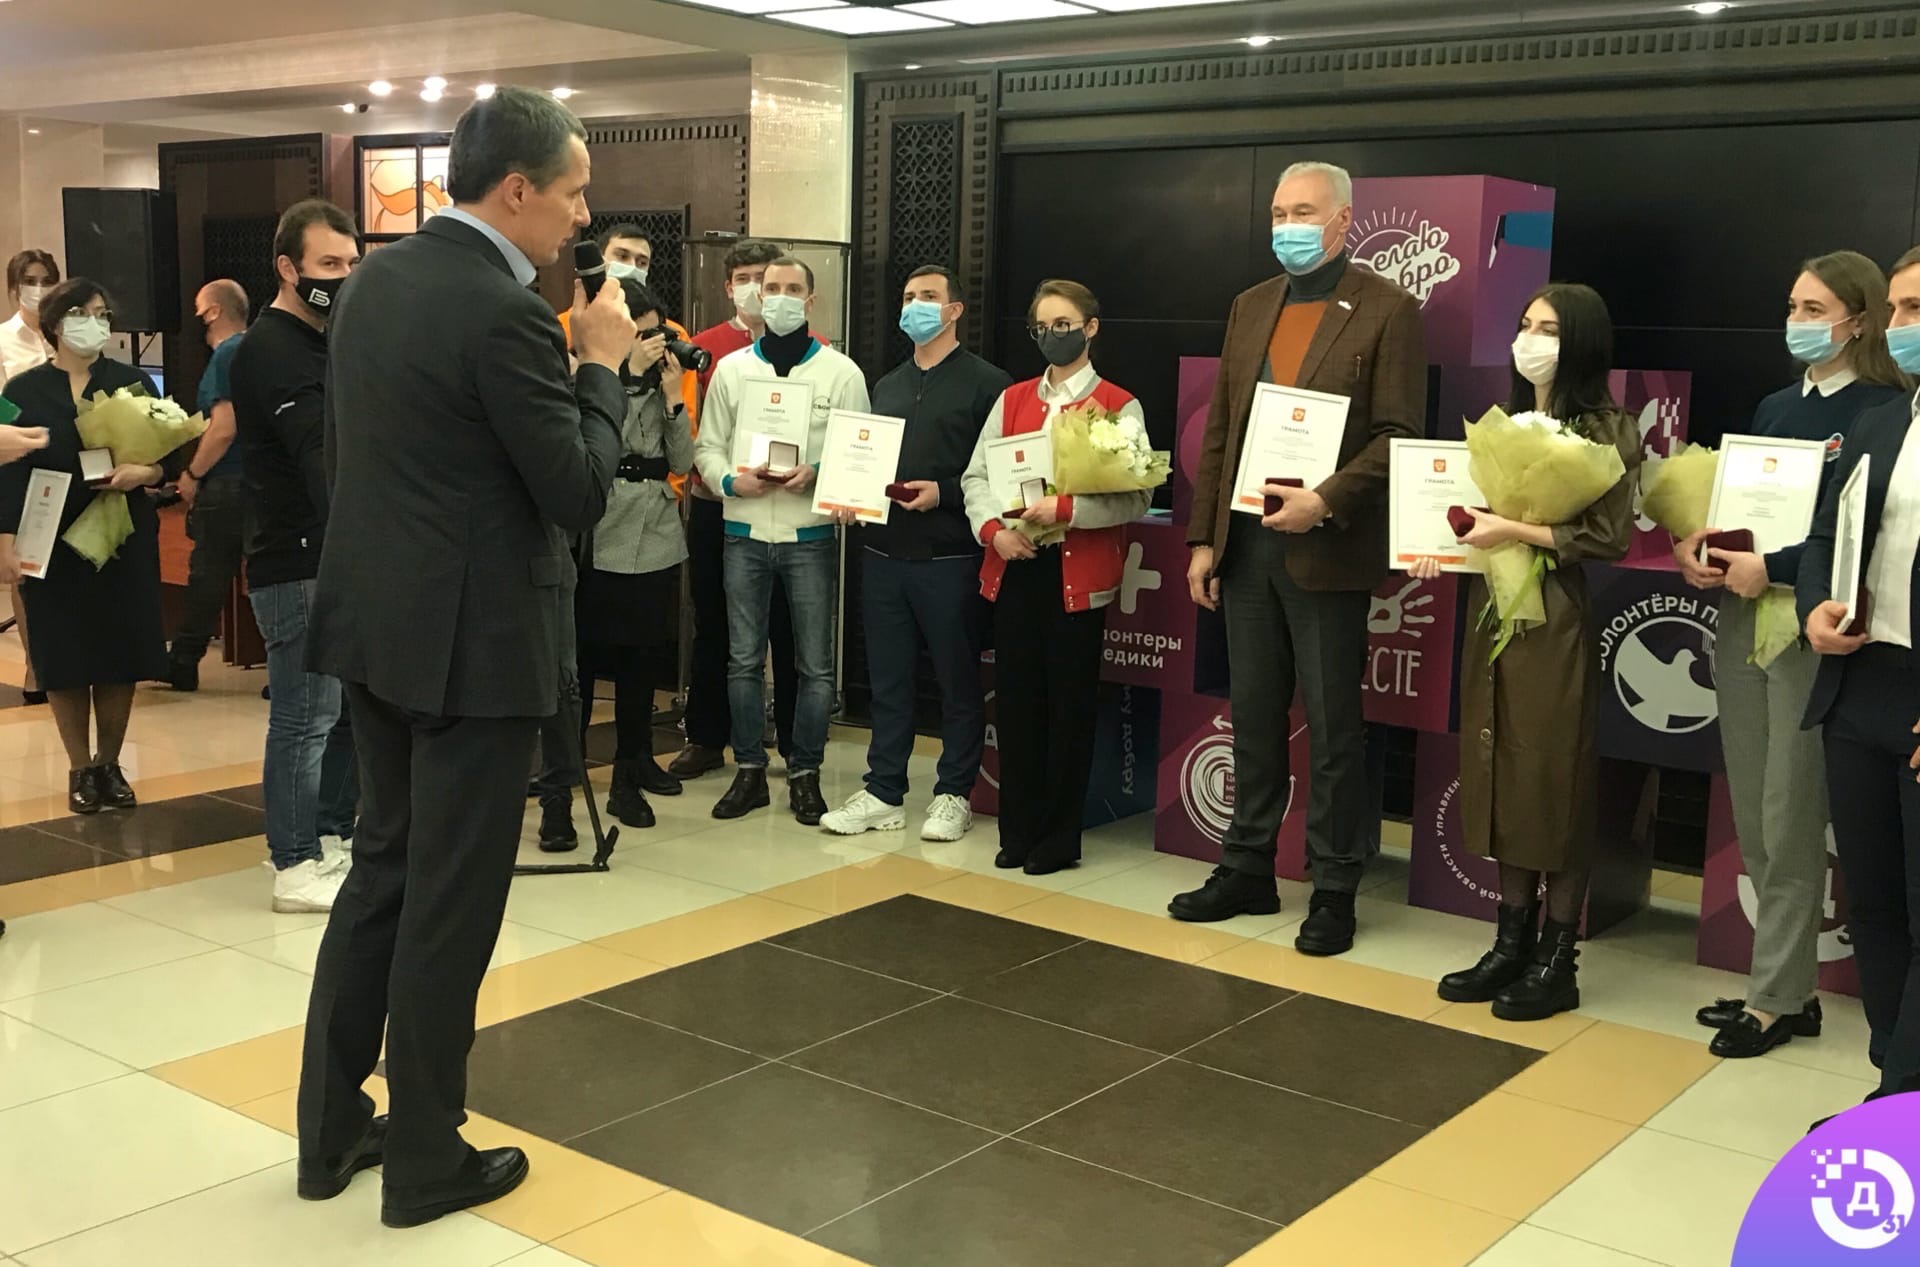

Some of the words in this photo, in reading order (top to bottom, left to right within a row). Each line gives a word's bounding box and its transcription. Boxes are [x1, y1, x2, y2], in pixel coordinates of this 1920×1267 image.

[1373, 221, 1448, 272] елаю
[1399, 255, 1455, 295] бро
[1600, 593, 1698, 672] ОЛОНТЁРЫ
[1103, 648, 1164, 669] едики
[1436, 776, 1461, 837] УПРАВЛЕН
[1440, 843, 1477, 891] ОБЛАСТИ
